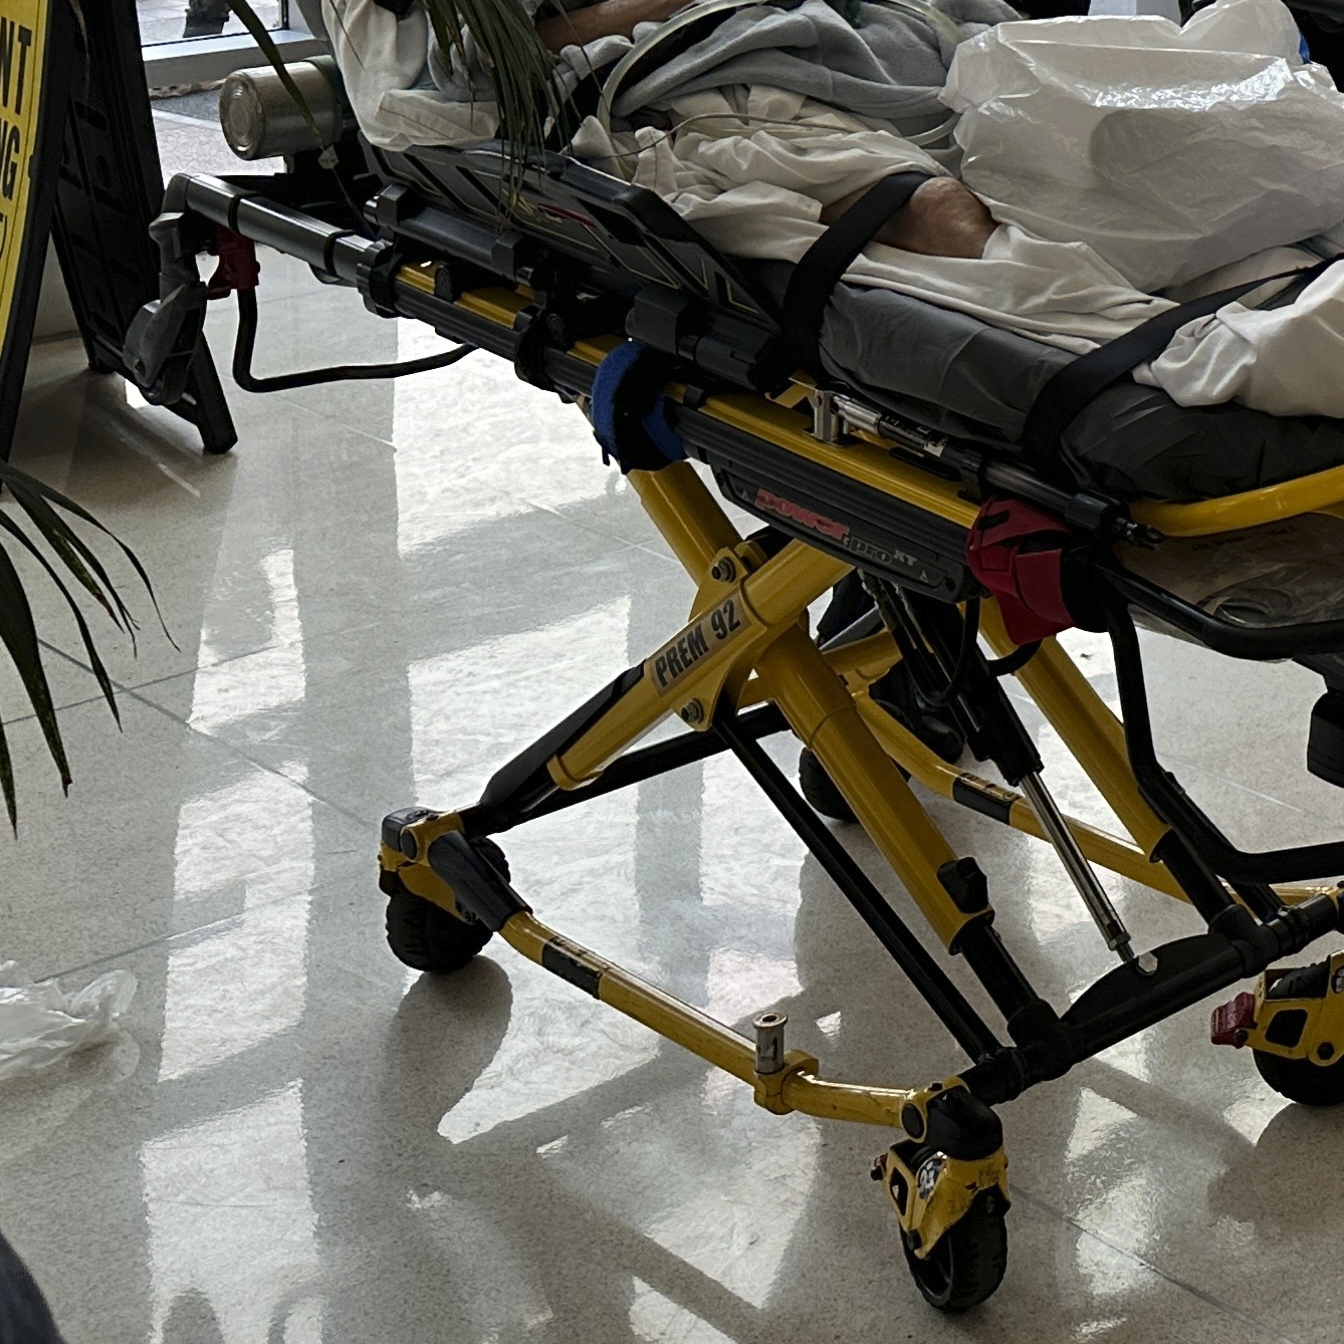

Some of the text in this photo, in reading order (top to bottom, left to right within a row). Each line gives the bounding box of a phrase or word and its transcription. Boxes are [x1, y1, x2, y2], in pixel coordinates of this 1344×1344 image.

[850, 536, 893, 566] pro
[893, 548, 918, 567] XT
[655, 599, 741, 687] PREM 92
